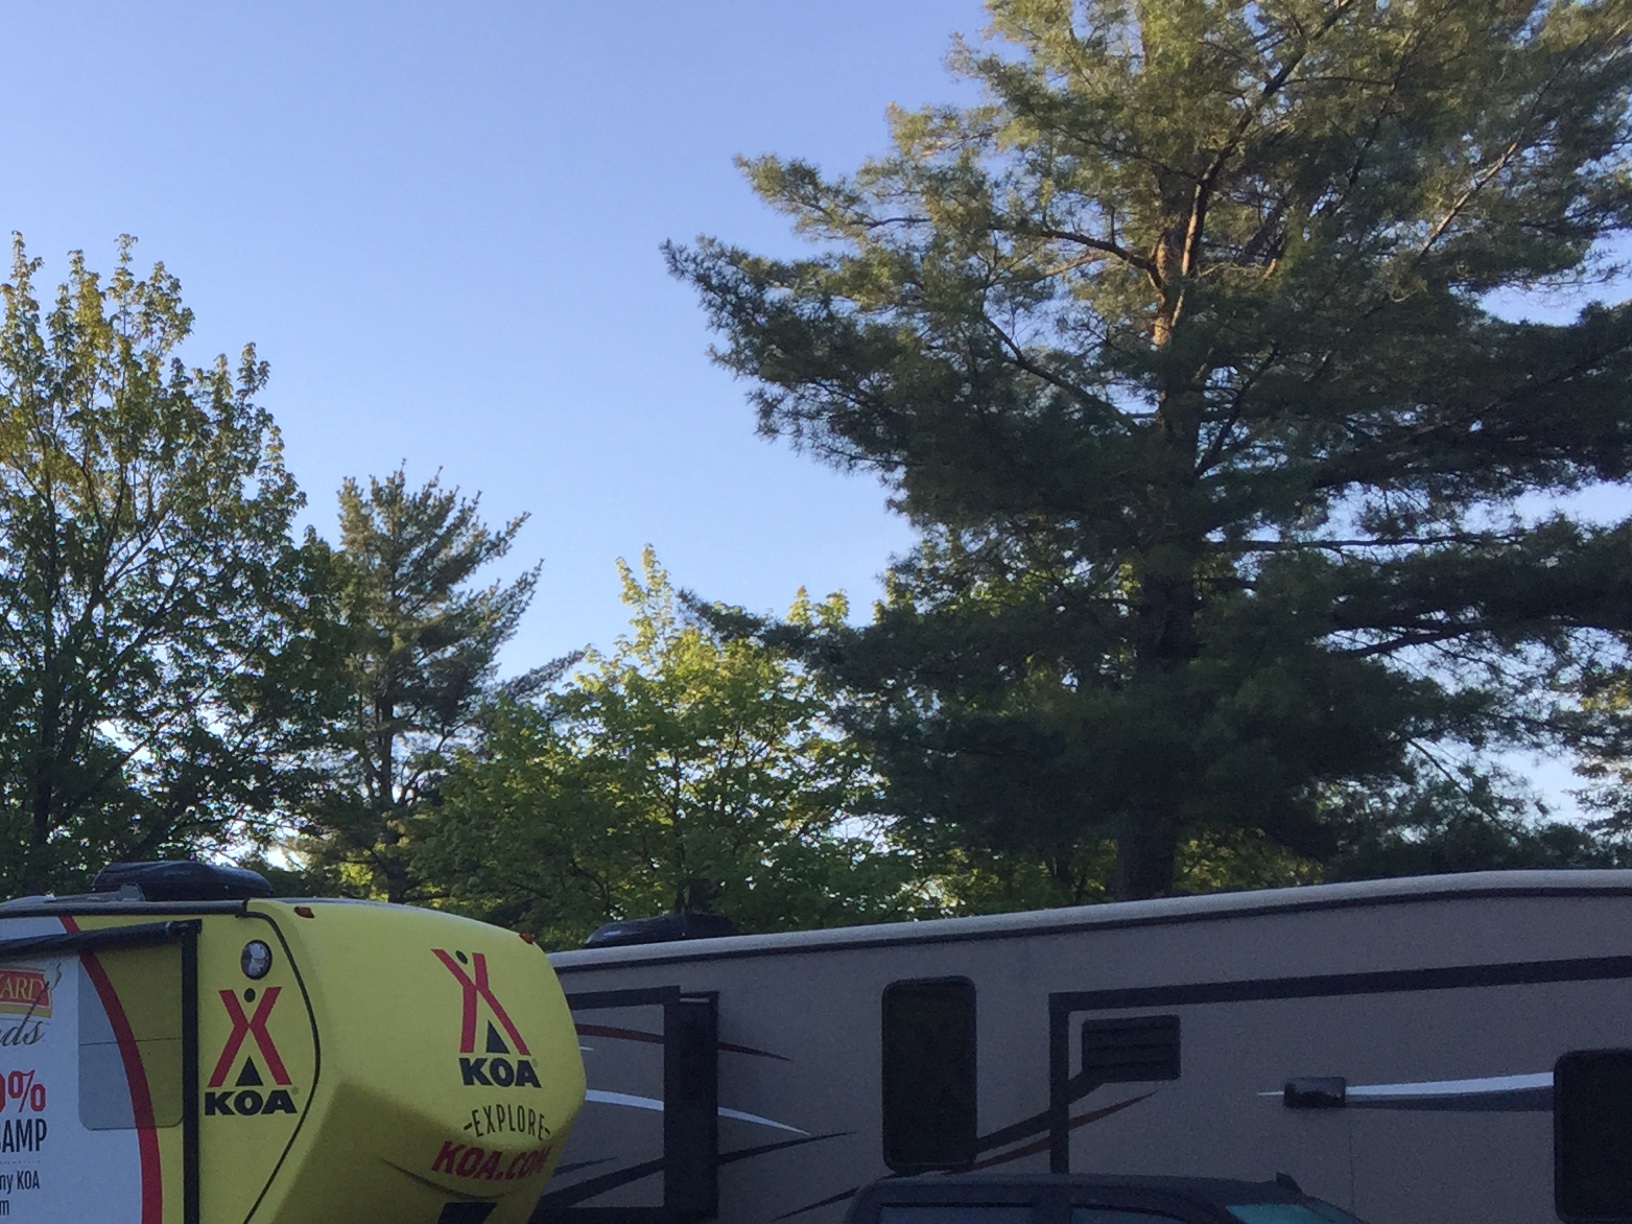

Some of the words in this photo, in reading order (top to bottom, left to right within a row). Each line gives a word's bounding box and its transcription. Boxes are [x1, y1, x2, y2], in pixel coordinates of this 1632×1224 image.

[459, 1058, 541, 1088] KOA
[205, 1090, 297, 1115] KOA
[17, 1170, 40, 1189] KOA
